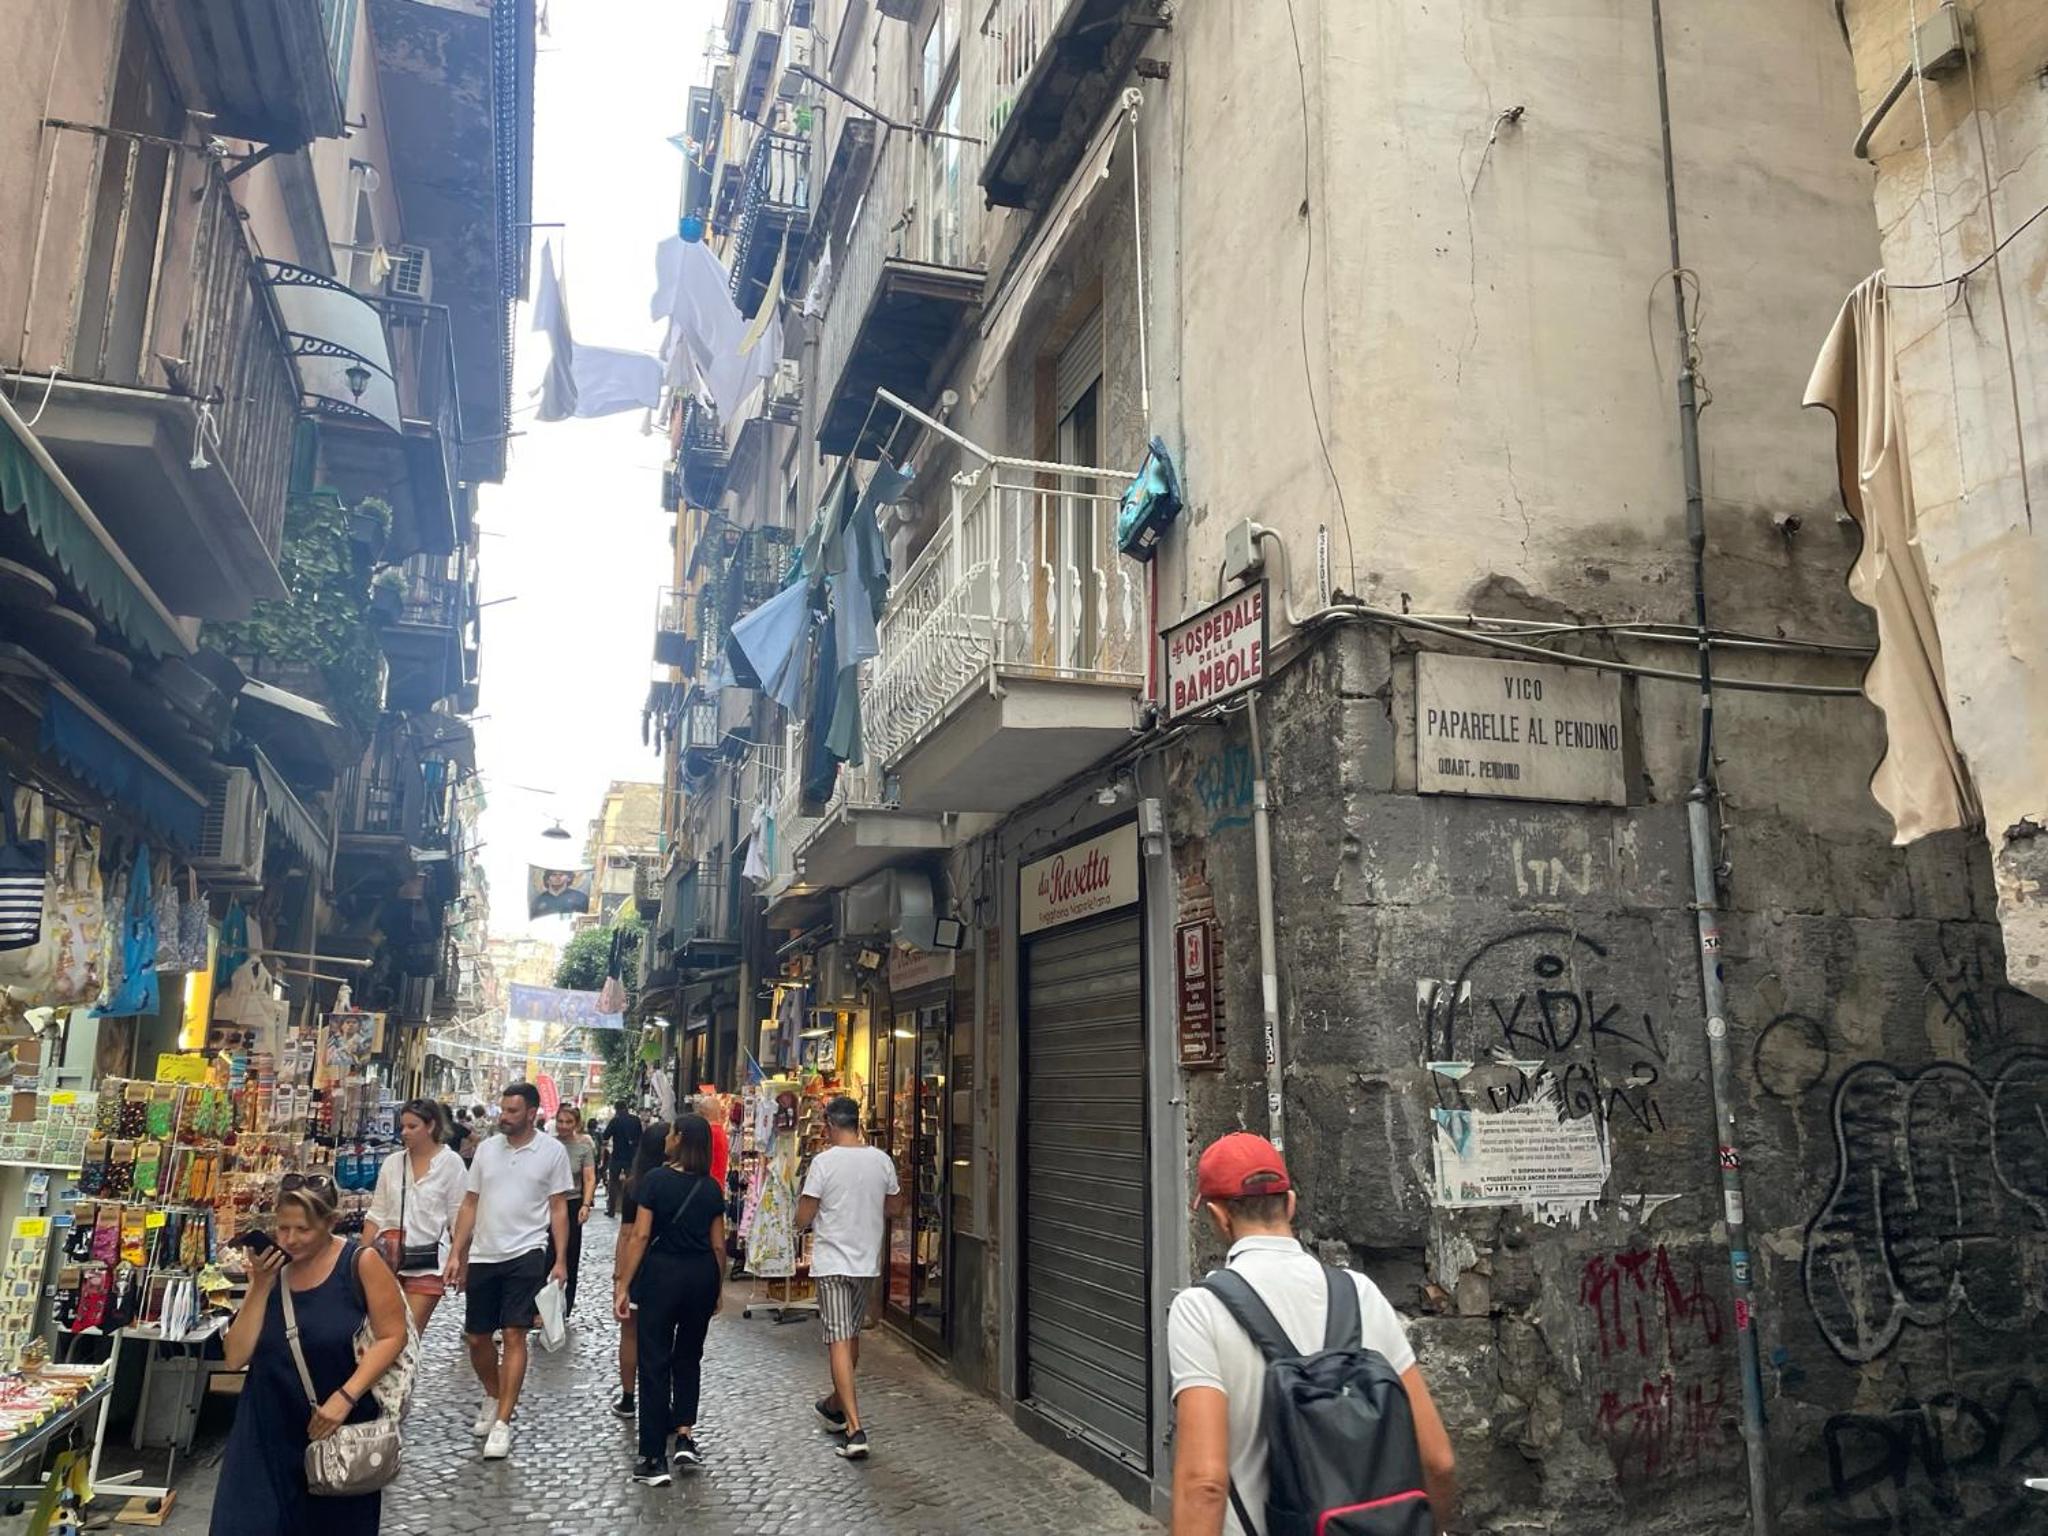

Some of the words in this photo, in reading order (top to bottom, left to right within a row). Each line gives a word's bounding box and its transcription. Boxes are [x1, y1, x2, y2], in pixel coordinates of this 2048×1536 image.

[1185, 593, 1262, 657] OSPEDALE
[1199, 640, 1233, 664] DELLE
[1174, 640, 1261, 711] BAMBOLE
[1504, 677, 1542, 701] VICO
[1428, 709, 1520, 743] PAPARELLE
[1528, 718, 1548, 745] AL
[1555, 720, 1618, 750] PENDINO
[1438, 758, 1475, 778] QUART.
[1479, 761, 1520, 780] PENDINO
